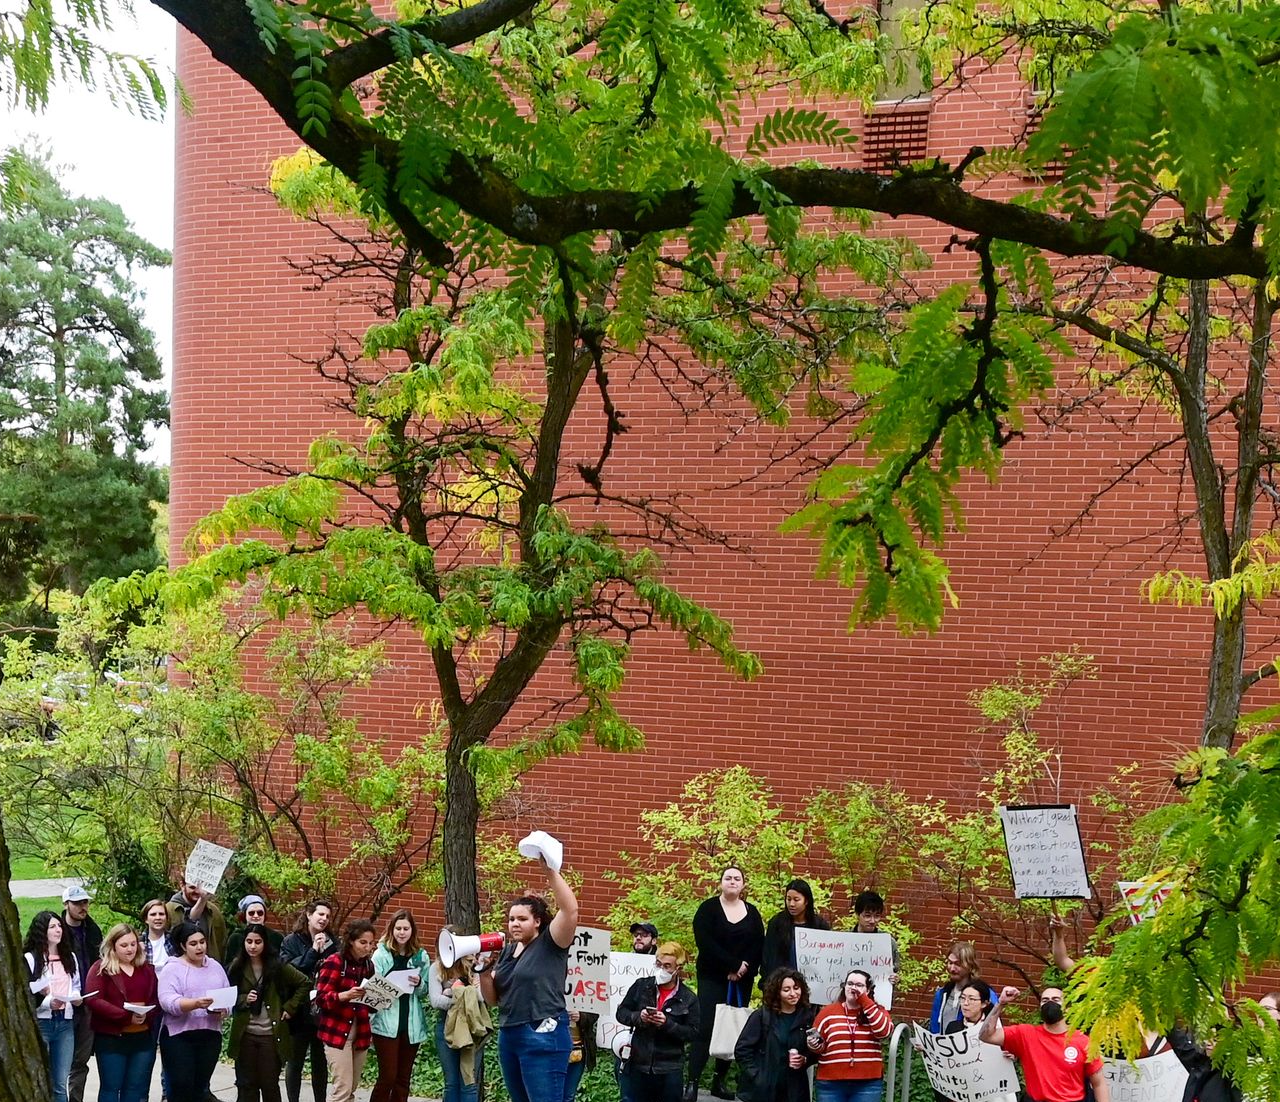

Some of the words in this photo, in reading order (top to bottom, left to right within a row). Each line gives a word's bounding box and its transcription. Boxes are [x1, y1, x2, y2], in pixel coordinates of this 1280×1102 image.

[576, 950, 608, 966] Fight
[870, 955, 893, 967] WSU
[567, 966, 584, 976] OR
[610, 961, 656, 977] SURVIV
[371, 977, 400, 997] WORK
[915, 1026, 968, 1057] WSU
[972, 1069, 985, 1083] &
[1111, 1083, 1167, 1102] UDENTS
